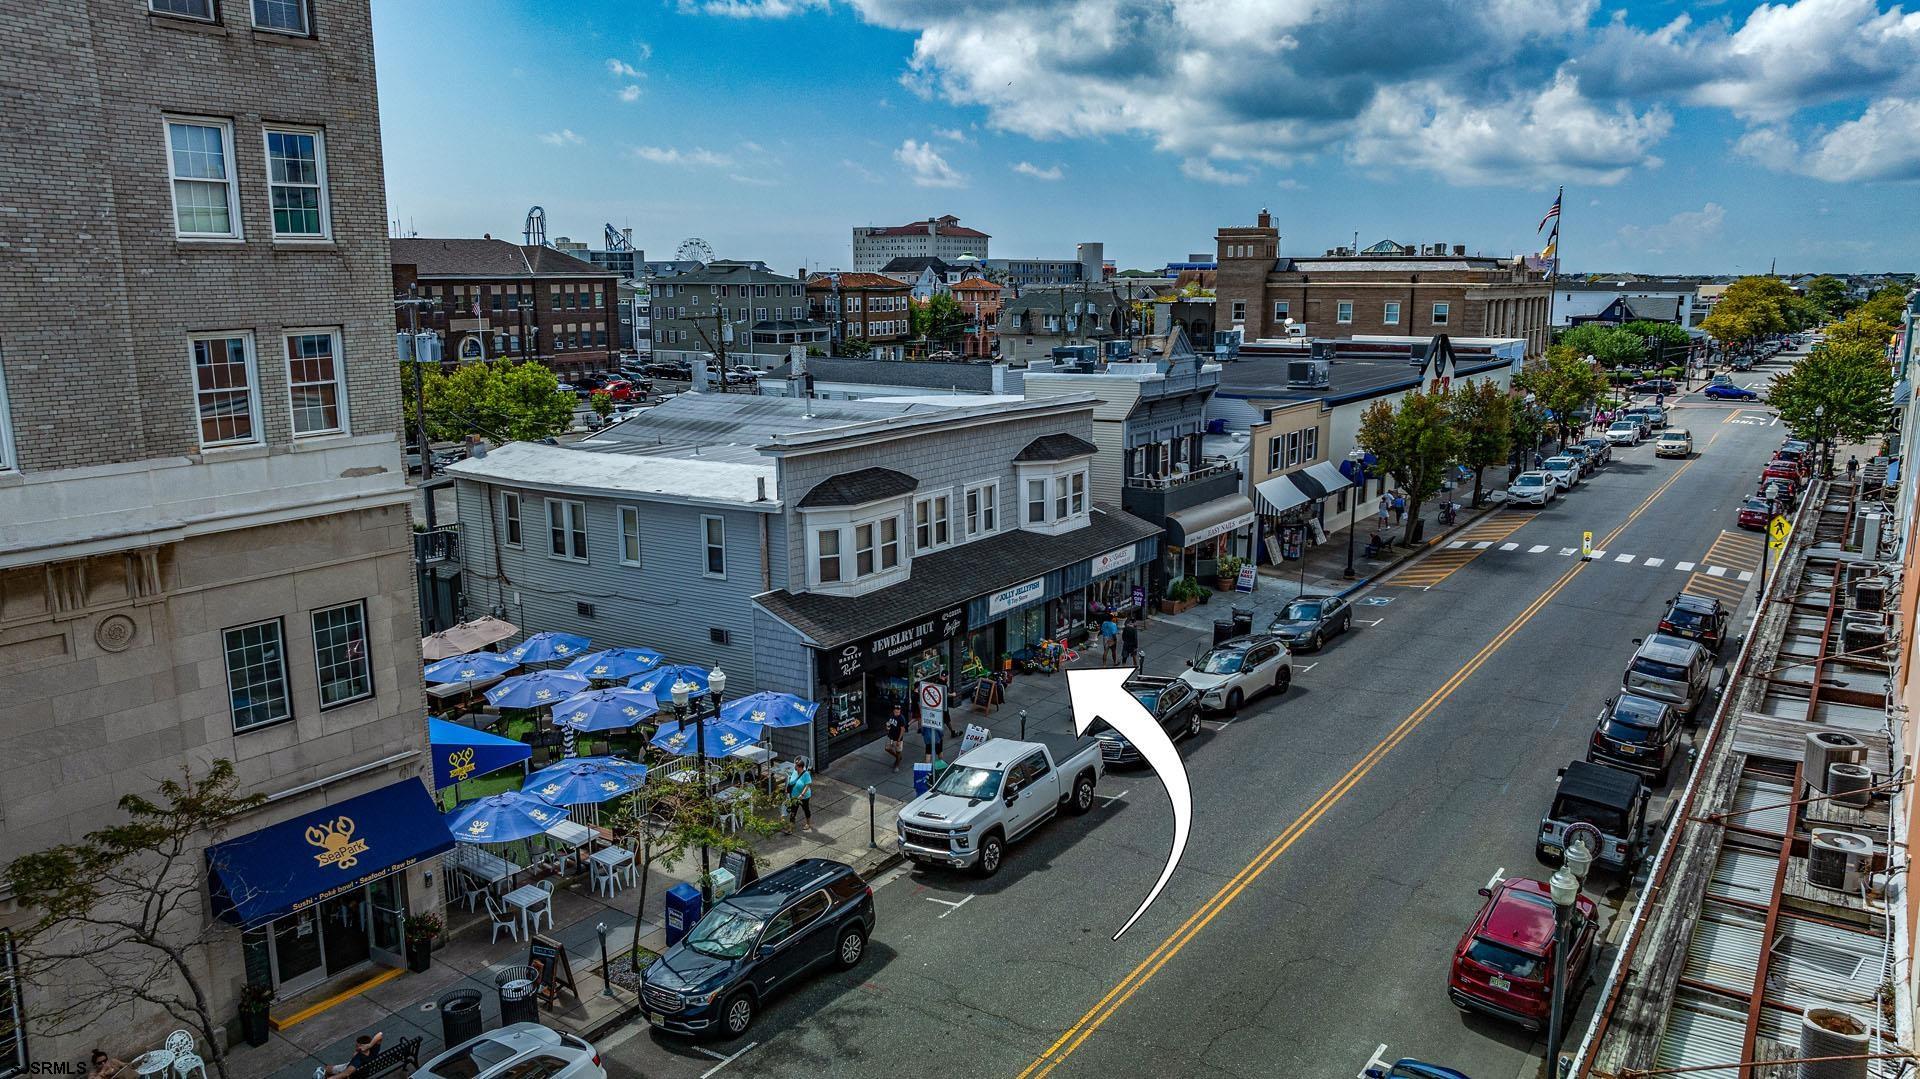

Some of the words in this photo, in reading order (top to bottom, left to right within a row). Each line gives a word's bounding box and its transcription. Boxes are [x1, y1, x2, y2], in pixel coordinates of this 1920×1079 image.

[1207, 527, 1220, 537] EASY
[1220, 521, 1236, 530] NAILS
[999, 589, 1015, 601] JOLLY
[1015, 581, 1040, 596] JELLYFISH
[871, 628, 915, 653] JEWELRY
[915, 621, 935, 636] HUT
[887, 643, 913, 657] Established
[923, 718, 942, 727] SIDEWALK
[965, 734, 984, 742] COME
[319, 841, 364, 864] SeaPark
[292, 897, 313, 911] Sushi
[337, 882, 354, 894] bowl
[359, 869, 386, 884] Seafood
[391, 862, 406, 872] Raw
[406, 857, 417, 867] bar
